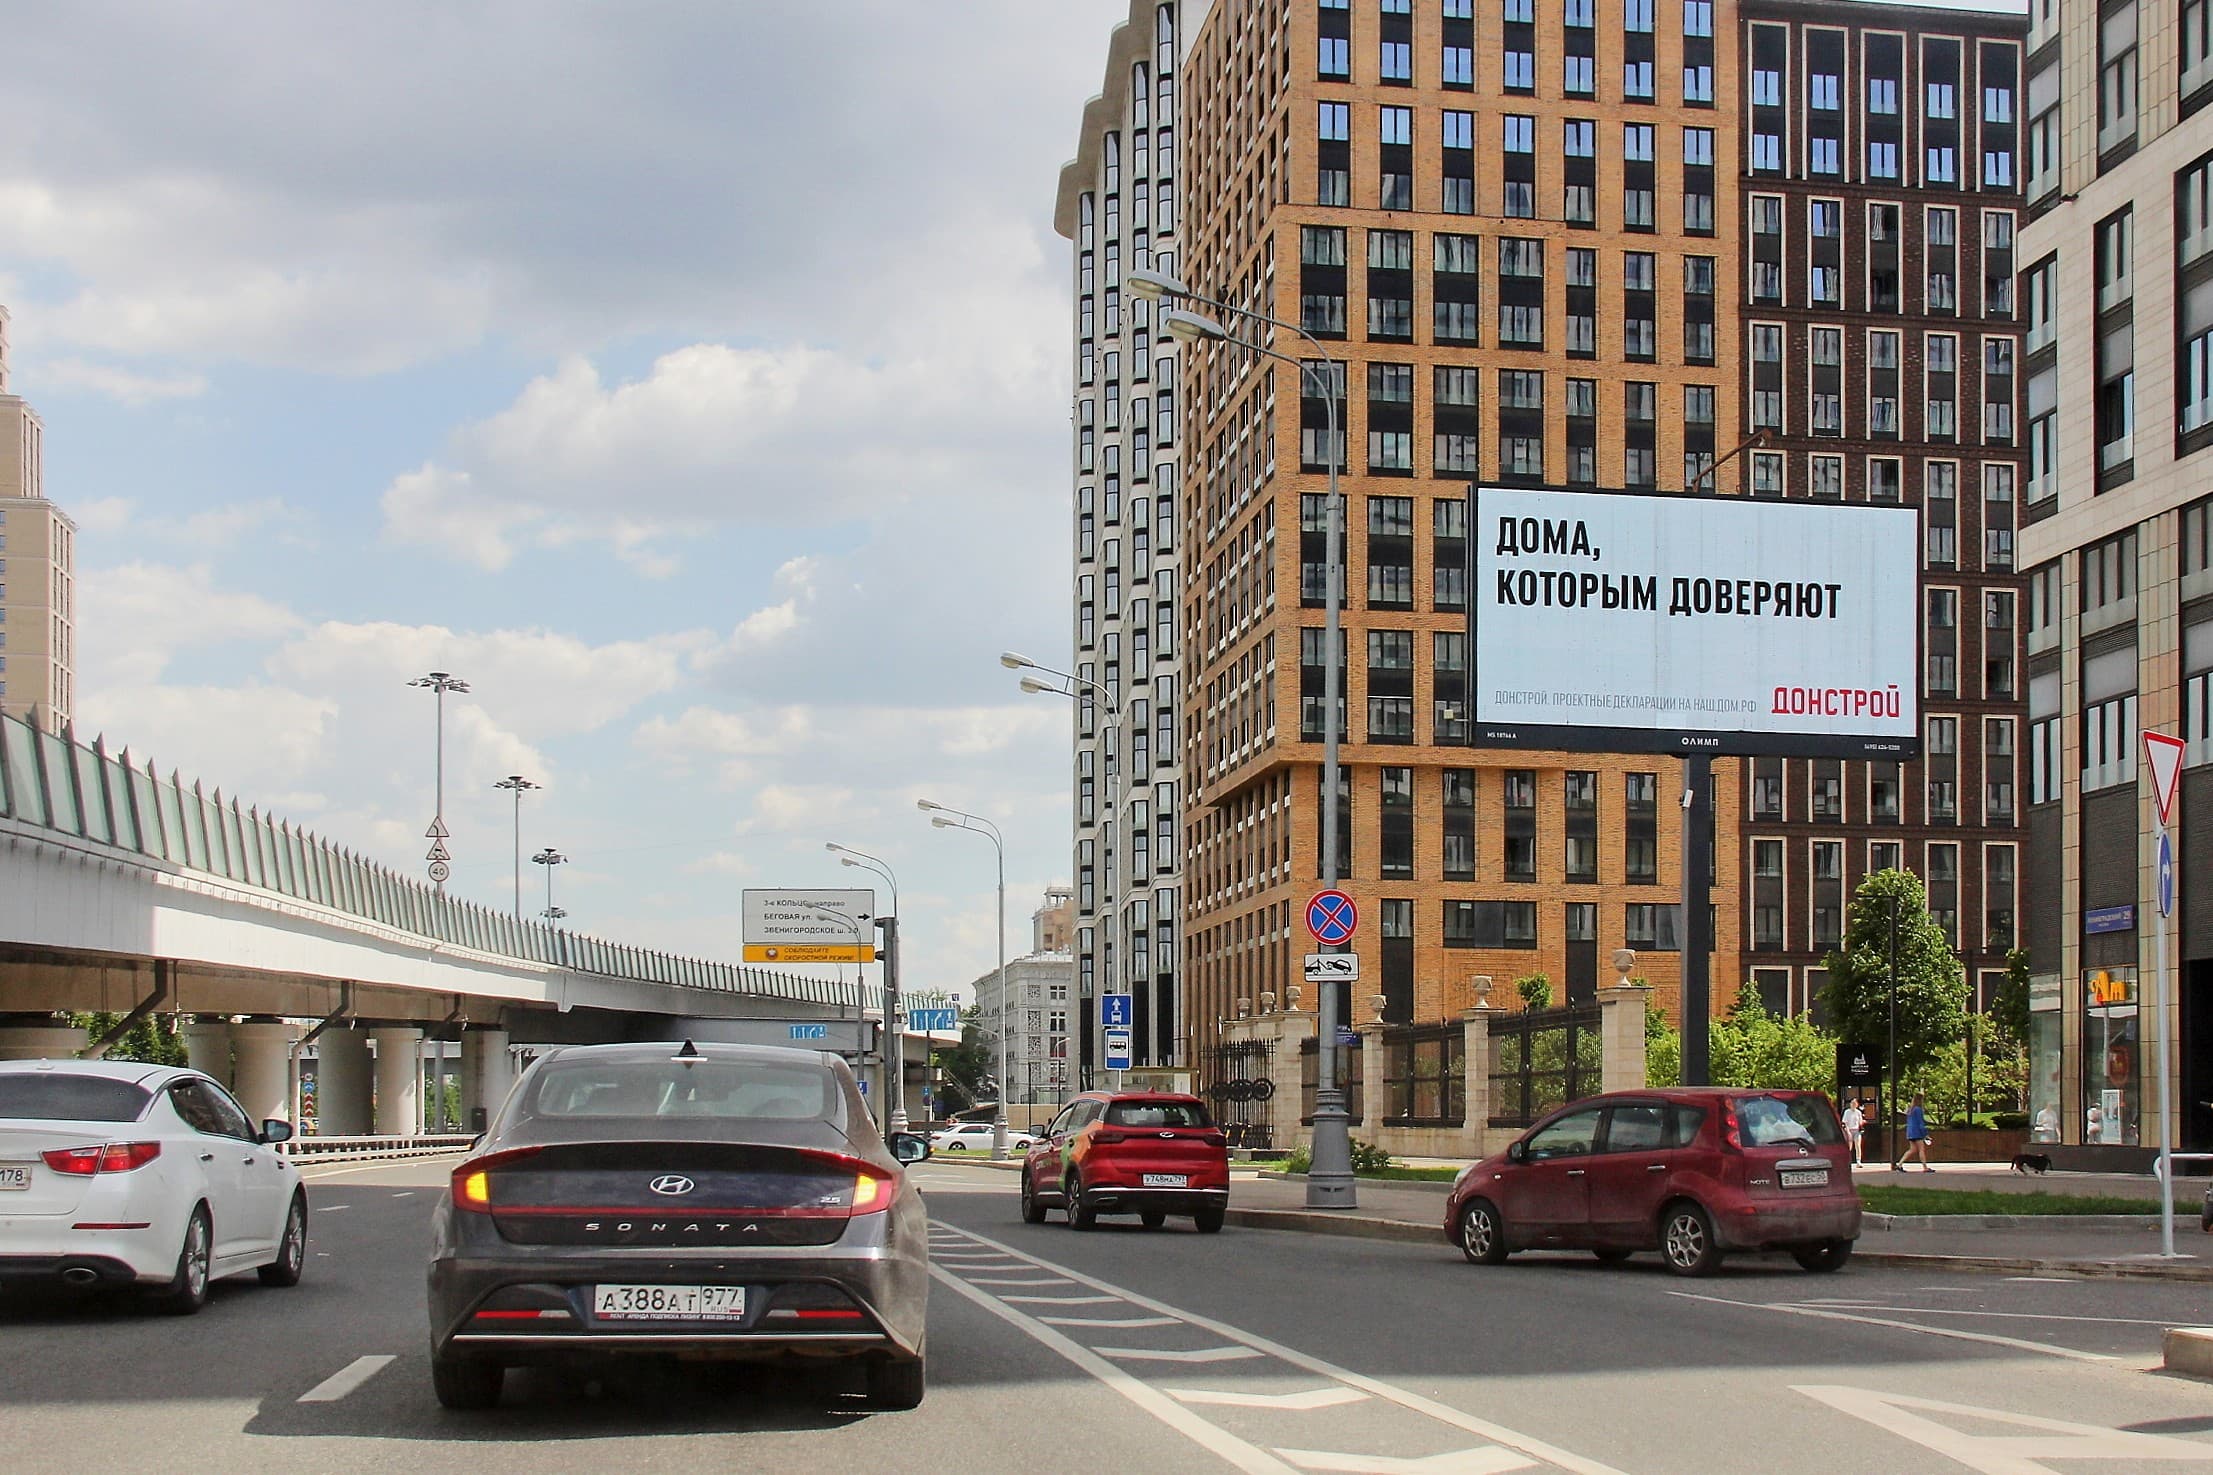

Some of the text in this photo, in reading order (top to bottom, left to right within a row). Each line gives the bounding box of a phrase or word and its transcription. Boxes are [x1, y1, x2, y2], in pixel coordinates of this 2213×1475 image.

[1496, 516, 1601, 562] ДОМА,
[1497, 568, 1842, 619] КОТОРЫМ ДОВЕРЯЮТ
[1552, 691, 1612, 708] ПРОЕКТНЫЕ
[1613, 694, 1676, 711] ДЕКЛАРАЦИИ
[1678, 697, 1691, 711] НА
[1770, 683, 1901, 719] ДОНСТРОЙ
[1681, 736, 1719, 746] ОЛИМП
[432, 867, 445, 876] 40
[764, 926, 835, 934] ЗВЕНИГОРОДСКОЕ
[0, 1169, 23, 1182] 178
[585, 1223, 758, 1232] SONATA
[702, 1287, 739, 1306] 977
